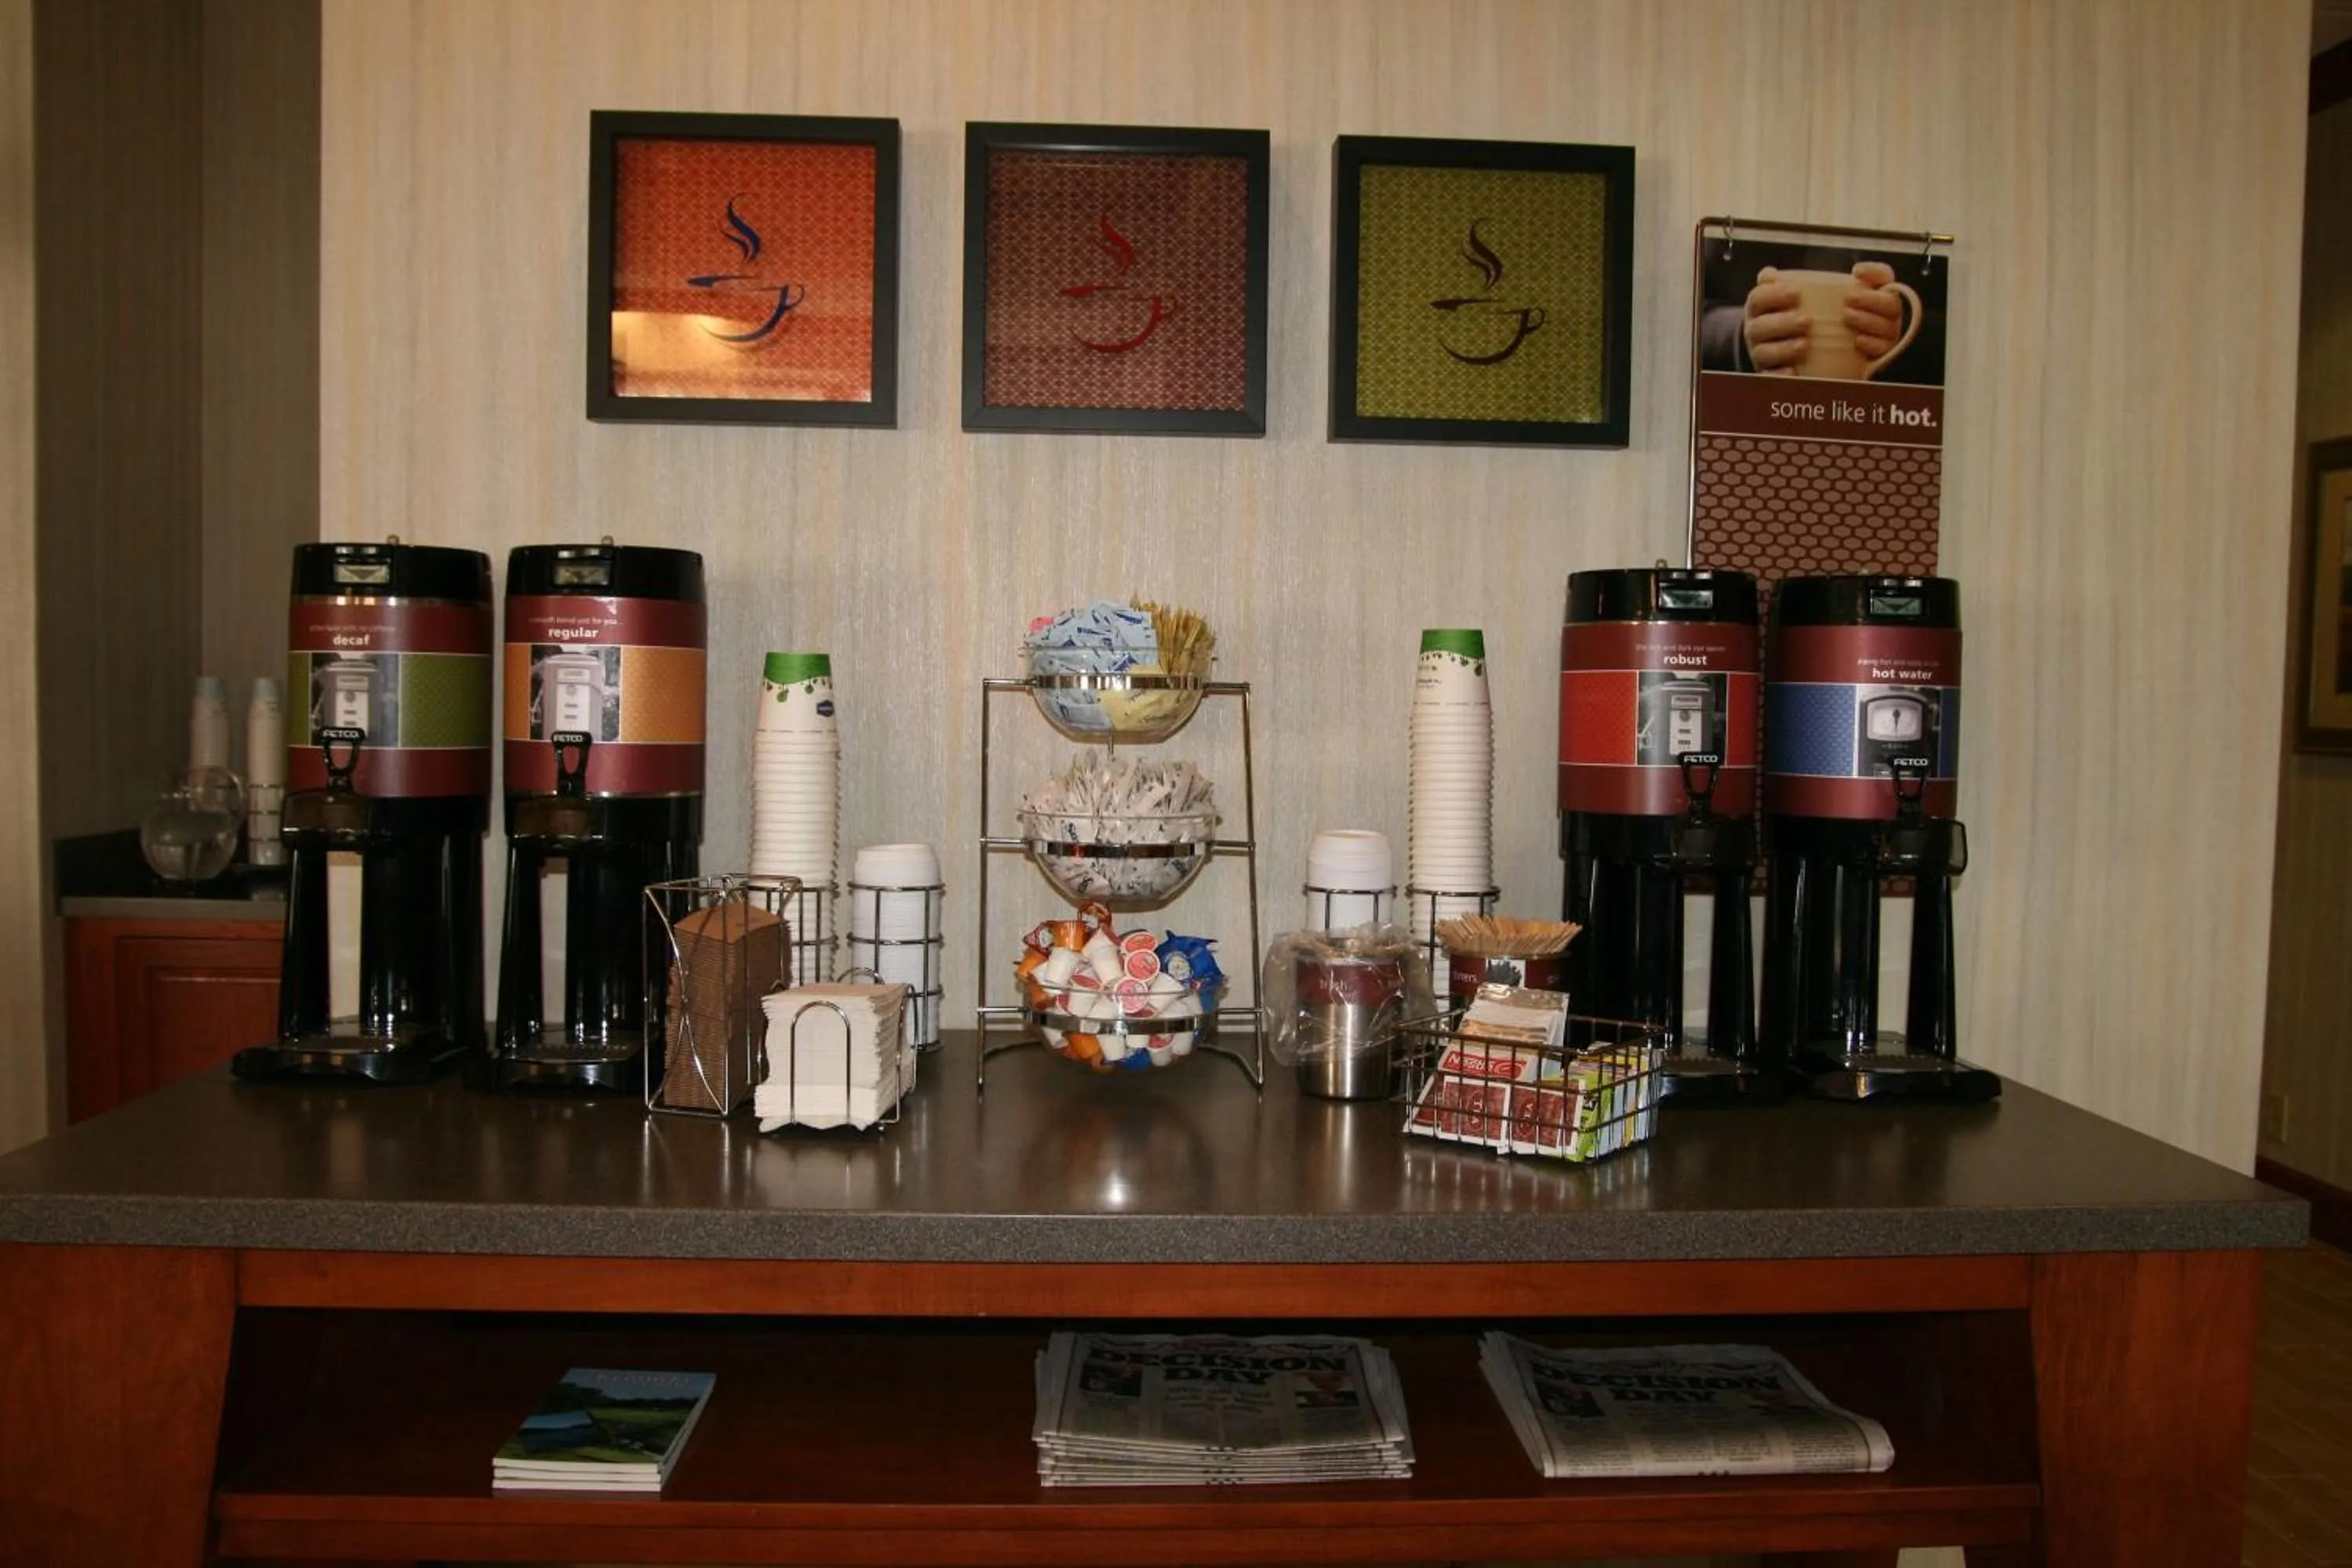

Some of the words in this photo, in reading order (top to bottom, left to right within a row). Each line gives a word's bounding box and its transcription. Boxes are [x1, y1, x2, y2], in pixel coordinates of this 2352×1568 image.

[1770, 401, 1825, 420] some
[1831, 400, 1866, 423] like
[1871, 401, 1886, 424] it
[1889, 403, 1937, 427] hot.
[332, 633, 370, 645] decaf
[548, 626, 599, 641] regular
[1663, 653, 1708, 666] robust
[1871, 667, 1895, 679] hot
[1899, 669, 1933, 680] water
[1087, 1348, 1346, 1371] DECISION
[1164, 1367, 1273, 1385] DAY
